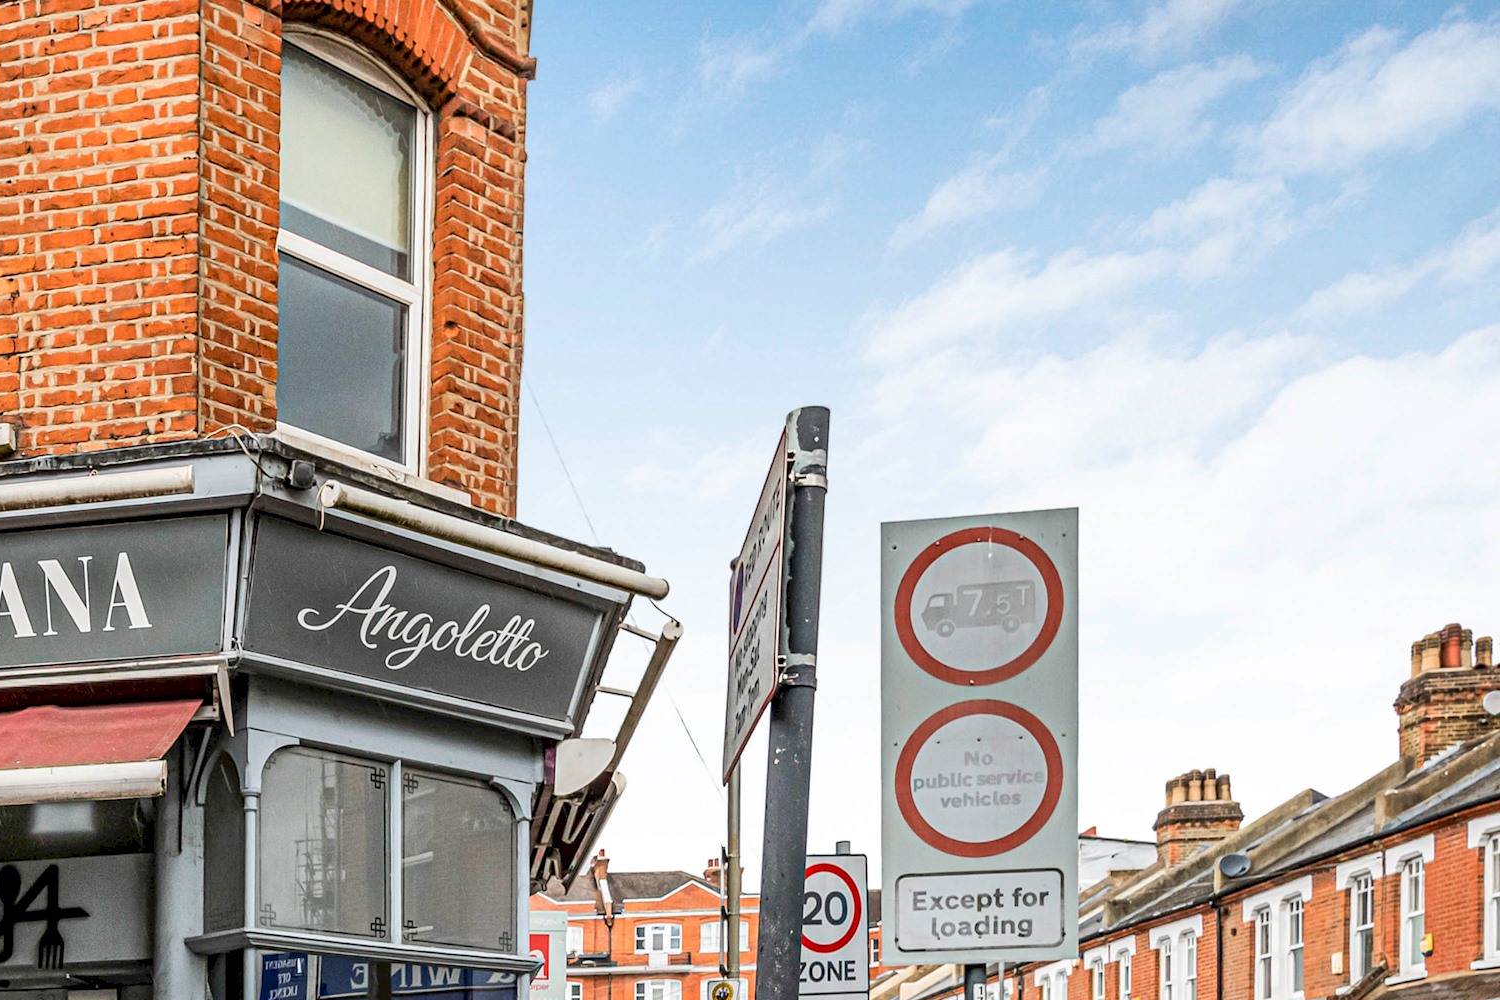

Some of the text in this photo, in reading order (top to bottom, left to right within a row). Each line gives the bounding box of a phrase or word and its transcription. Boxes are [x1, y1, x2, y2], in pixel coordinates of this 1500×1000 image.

[745, 477, 781, 590] RED ROUTE
[297, 565, 549, 671] Angoletto
[964, 751, 994, 767] No
[913, 769, 1045, 793] public service
[940, 791, 1022, 809] vehicles
[802, 890, 848, 926] 20
[912, 887, 1050, 913] Except for
[931, 915, 1034, 939] loading
[799, 960, 857, 983] ZONE
